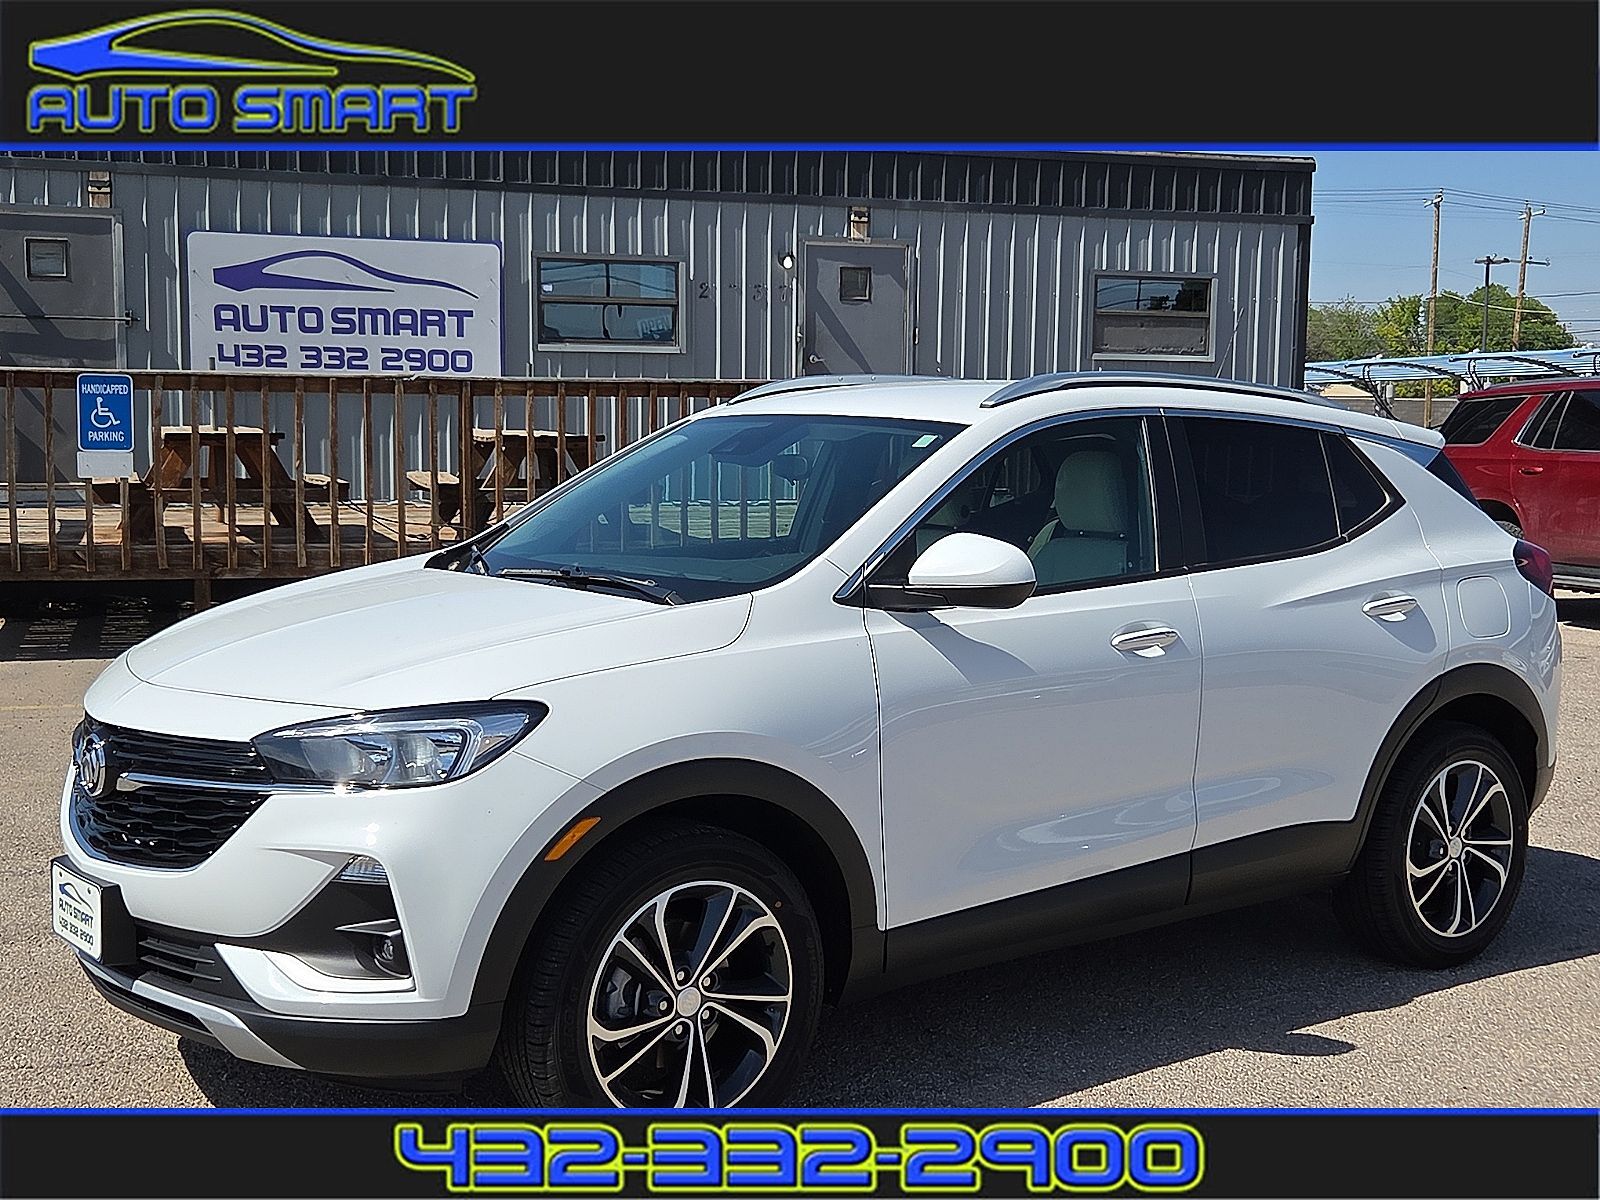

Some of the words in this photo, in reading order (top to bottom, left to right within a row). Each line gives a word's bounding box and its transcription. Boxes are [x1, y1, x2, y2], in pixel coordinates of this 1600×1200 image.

[213, 303, 324, 334] AUTO
[331, 306, 474, 338] SMART
[217, 343, 288, 369] 432
[299, 345, 369, 370] 332
[380, 347, 473, 373] 2900
[81, 383, 129, 395] HANDICAPPED
[88, 430, 125, 442] PARKING
[58, 897, 73, 916] AUTO
[73, 905, 94, 929] SMART
